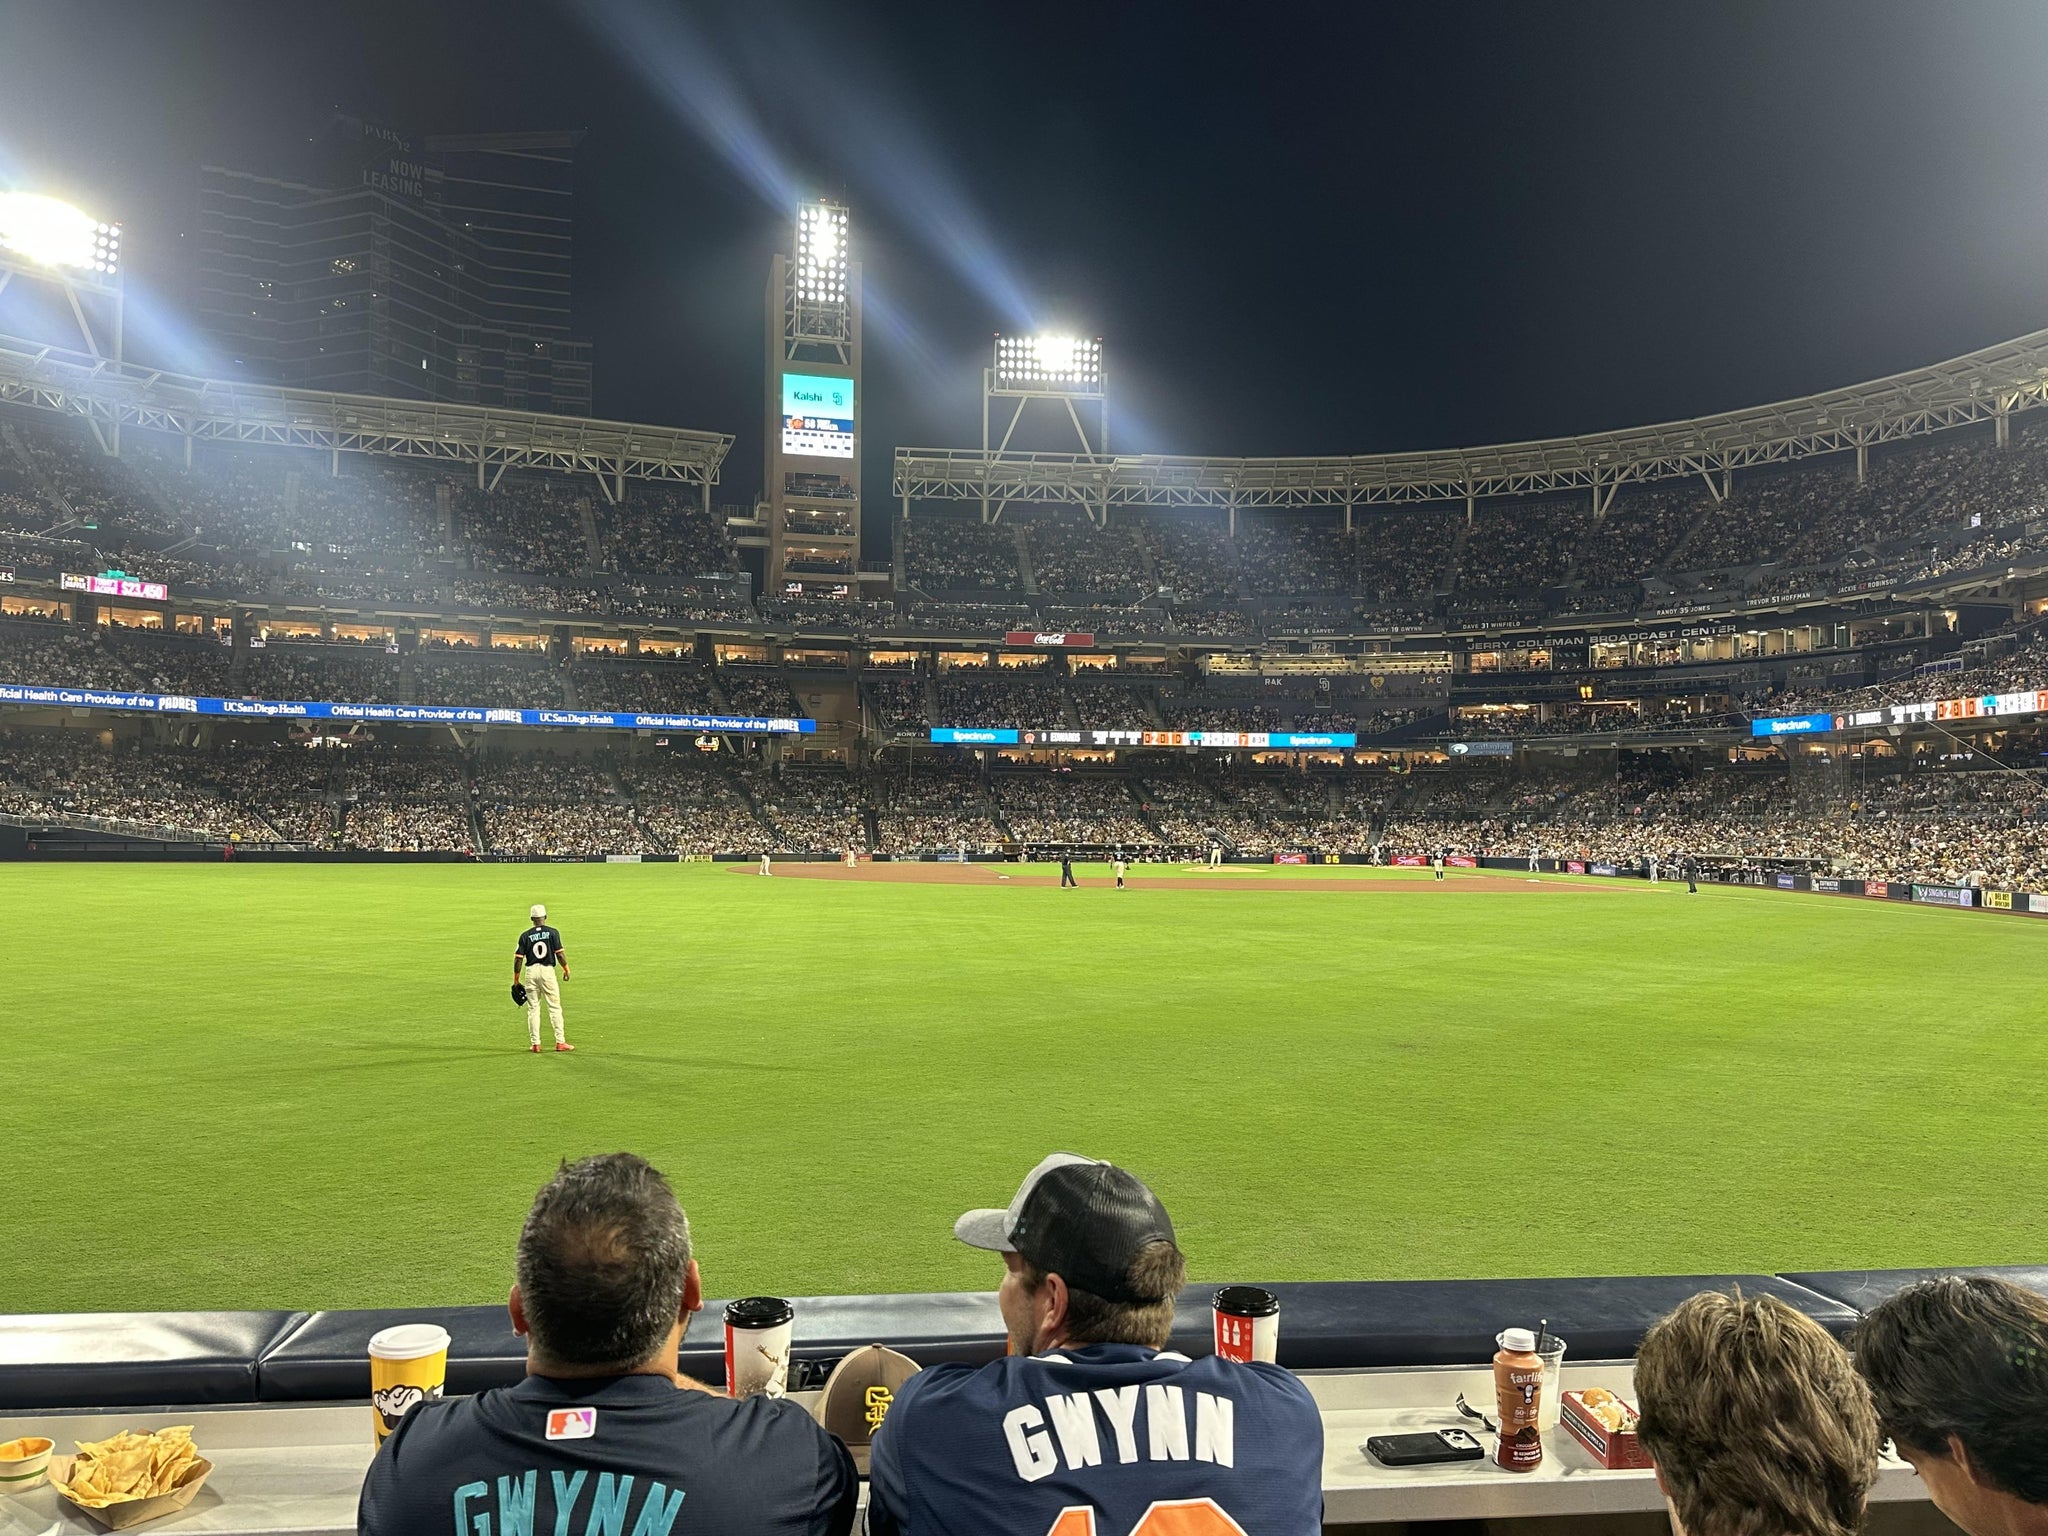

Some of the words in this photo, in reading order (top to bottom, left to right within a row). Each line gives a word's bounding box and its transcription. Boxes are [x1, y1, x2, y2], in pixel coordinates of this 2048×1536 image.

[390, 160, 423, 179] NOW
[363, 169, 423, 197] LEASING
[793, 391, 823, 402] Kalshi
[1837, 586, 1857, 594] JACKIE
[1867, 578, 1898, 588] ROBINSON
[1746, 598, 1769, 606] TREVOR
[1771, 595, 1780, 604] 51
[1780, 592, 1811, 602] HOFFMAN
[1656, 608, 1677, 616] RANDY
[1679, 606, 1689, 614] 35
[1690, 605, 1711, 613] JONES
[1034, 633, 1066, 645] Coca-Cola
[1467, 641, 1511, 650] JERRY
[1516, 637, 1584, 648] COLEMAN
[1590, 630, 1676, 644] BROADCAST
[1681, 624, 1737, 637] CENTER
[1264, 678, 1283, 686] RAK
[24, 690, 58, 701] Health
[59, 691, 83, 703] Care
[84, 692, 125, 706] Provider
[127, 696, 138, 706] of
[138, 696, 154, 707] the
[158, 696, 198, 712] PADRES
[254, 703, 278, 716] Diego
[278, 704, 306, 715] Health
[331, 706, 364, 717] Official
[365, 706, 394, 717] Health
[396, 708, 417, 718] Care
[418, 708, 455, 720] Provider
[457, 709, 467, 720] of
[467, 709, 482, 720] the
[485, 709, 522, 723] PADRES
[567, 714, 590, 725] Diego
[589, 714, 614, 725] Health
[636, 716, 664, 726] Official
[665, 716, 691, 727] Health
[692, 717, 711, 728] Care
[711, 718, 743, 729] Provider
[744, 719, 753, 729] of
[753, 719, 767, 729] the
[768, 719, 800, 732] PADRES
[1771, 721, 1809, 732] Spectrum
[953, 731, 994, 742] Spectrum
[1050, 732, 1081, 743] EDWARDS
[1290, 735, 1331, 746] Spectrum
[1928, 888, 1947, 898] SINGING
[1947, 890, 1960, 899] HILLS
[529, 931, 550, 942] TAYLOR
[532, 940, 548, 960] 0
[1002, 1384, 1235, 1483] GWYNN
[453, 1469, 686, 1536] GWYNN
